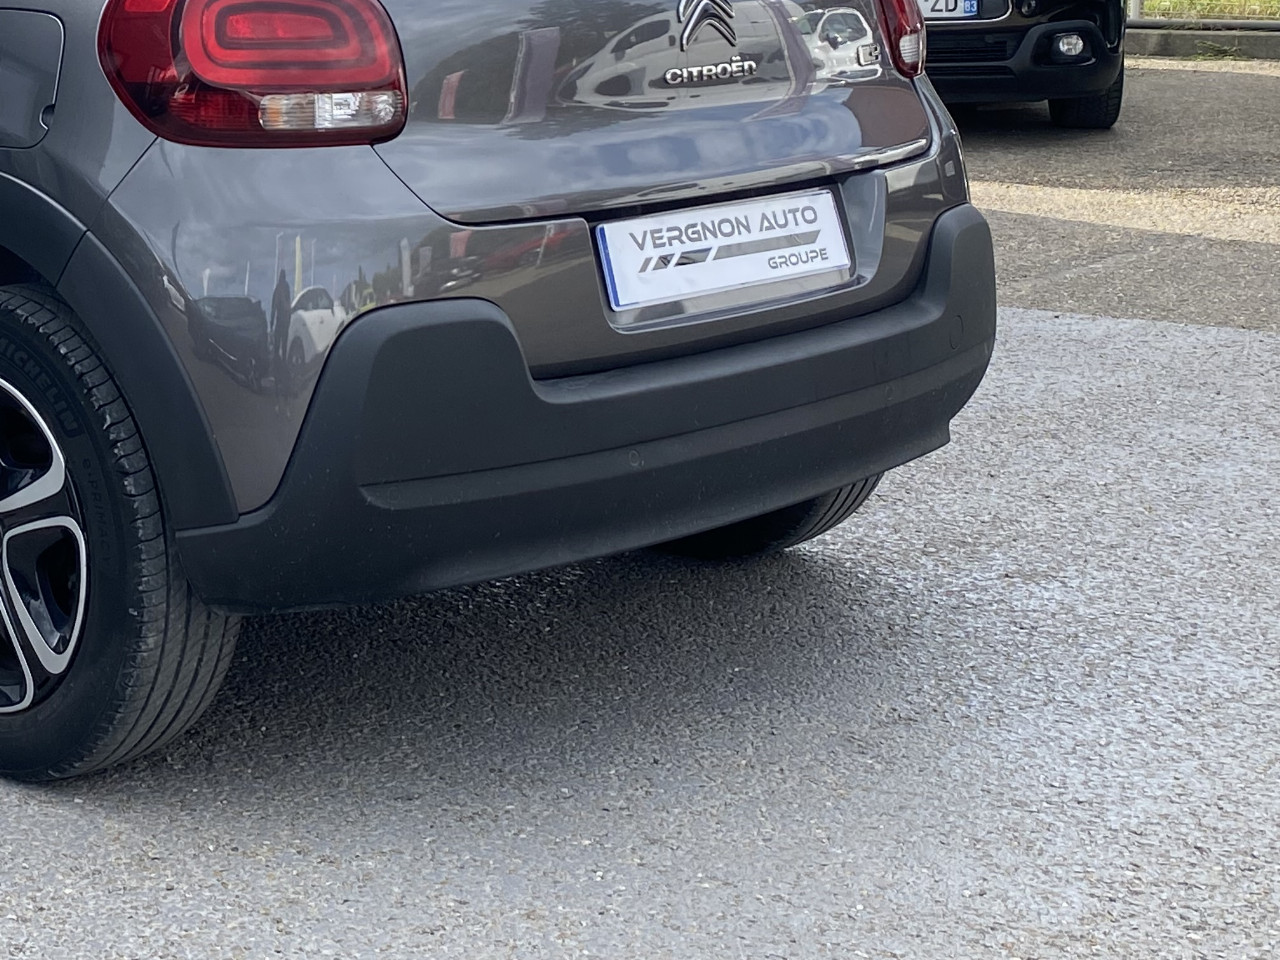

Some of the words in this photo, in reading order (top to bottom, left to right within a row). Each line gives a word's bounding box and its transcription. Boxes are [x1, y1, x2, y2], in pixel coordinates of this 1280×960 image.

[628, 214, 752, 252] VERGNON
[758, 205, 818, 234] AUTO
[767, 246, 829, 270] GROUPE
